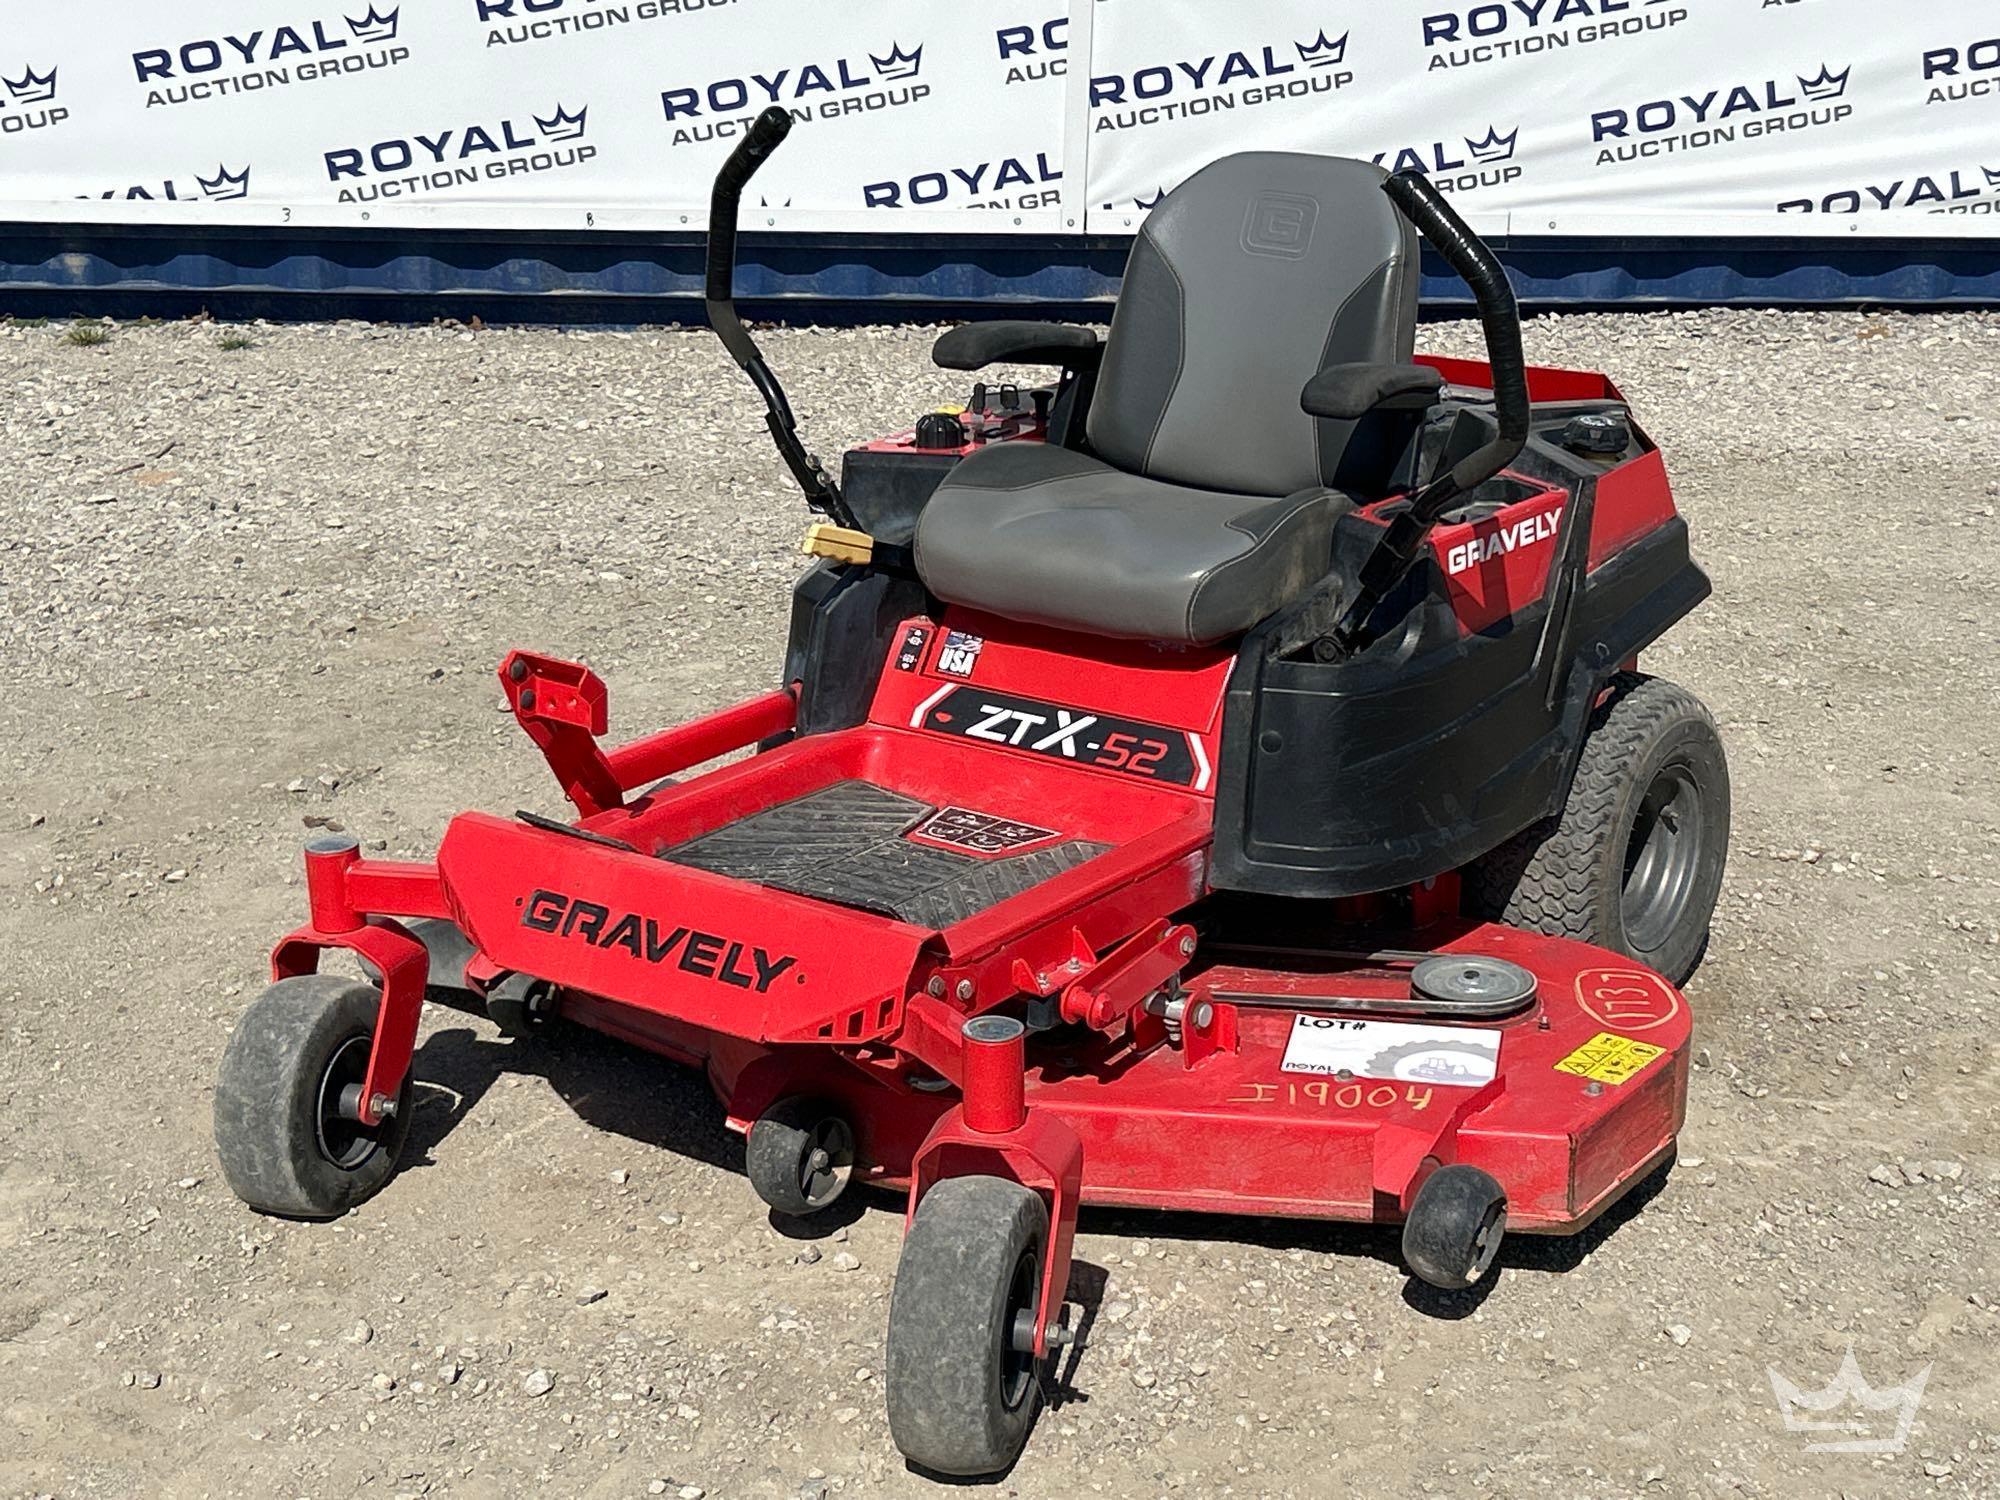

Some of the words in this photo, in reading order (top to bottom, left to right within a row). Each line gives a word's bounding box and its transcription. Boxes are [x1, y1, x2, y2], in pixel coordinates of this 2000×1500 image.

[132, 21, 347, 84] ROYAL
[486, 7, 630, 48] AUCTION
[1428, 31, 1570, 72] AUCTION
[1577, 8, 1688, 44] GROUP
[145, 67, 290, 108] AUCTION
[296, 46, 411, 83] GROUP
[660, 57, 871, 122] ROYAL
[1089, 45, 1295, 108] ROYAL
[1095, 88, 1235, 134] AUCTION
[1242, 70, 1353, 106] GROUP
[672, 105, 812, 147] AUCTN
[819, 84, 931, 119] GROUP
[1590, 79, 1796, 142] ROYAL
[1595, 124, 1735, 166] AUCTION
[1743, 103, 1853, 138] GROUP
[324, 120, 536, 181] ROYAL
[337, 167, 479, 204] AUCTION
[485, 145, 597, 179] GROUP
[1435, 166, 1523, 194] ROUP
[1447, 507, 1563, 575] GRAVELY
[938, 647, 975, 675] USA
[965, 703, 1168, 775] ZTX-52
[521, 888, 798, 993] GRAVELY
[1299, 1016, 1367, 1031] LOT#
[1285, 1062, 1335, 1074] ROYAL
